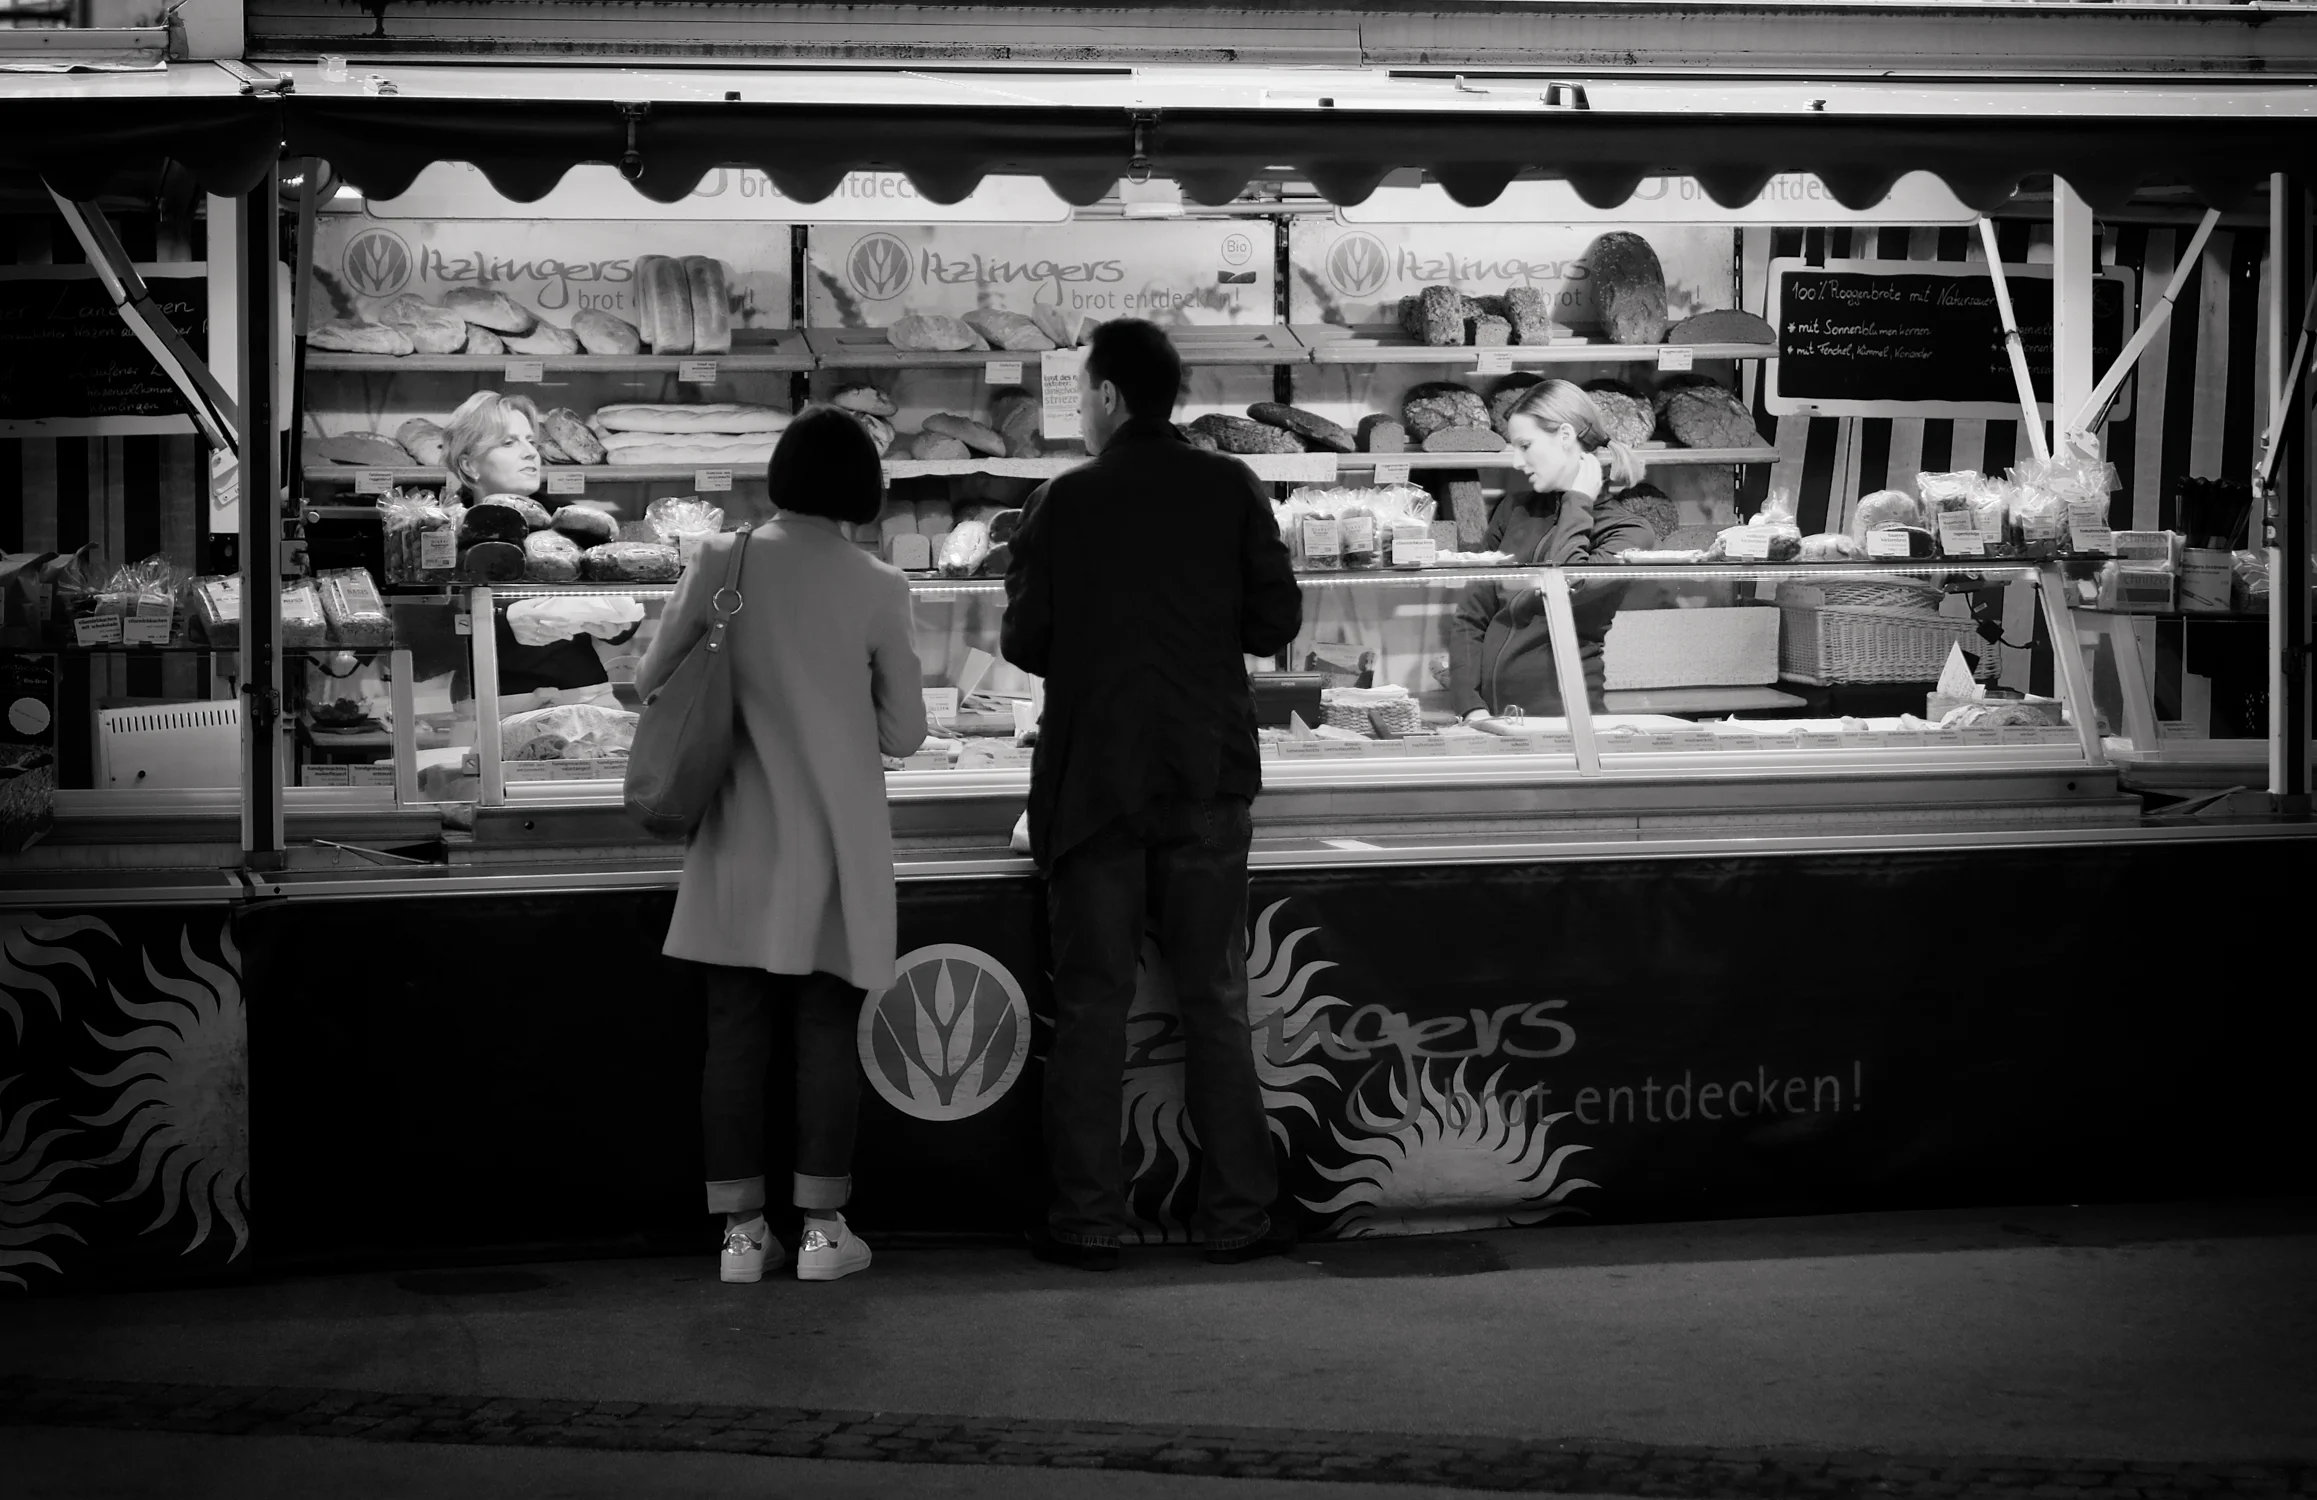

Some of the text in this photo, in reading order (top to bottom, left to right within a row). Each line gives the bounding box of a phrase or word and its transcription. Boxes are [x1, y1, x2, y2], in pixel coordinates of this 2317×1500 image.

[1226, 239, 1248, 253] Bio
[420, 243, 633, 310] Itzlingers
[921, 246, 1125, 306] Itzlingers
[1396, 244, 1592, 288] Itzlingers
[578, 288, 624, 310] brot
[1072, 286, 1240, 310] brot entdecken!
[1540, 287, 1582, 308] brot
[1828, 279, 1902, 307] Roggenbrote
[1909, 284, 1932, 304] mit
[1798, 318, 1820, 334] mit
[1796, 340, 1815, 356] mit
[346, 588, 369, 596] BASIS
[1443, 1060, 1862, 1131] brot entdecken!
